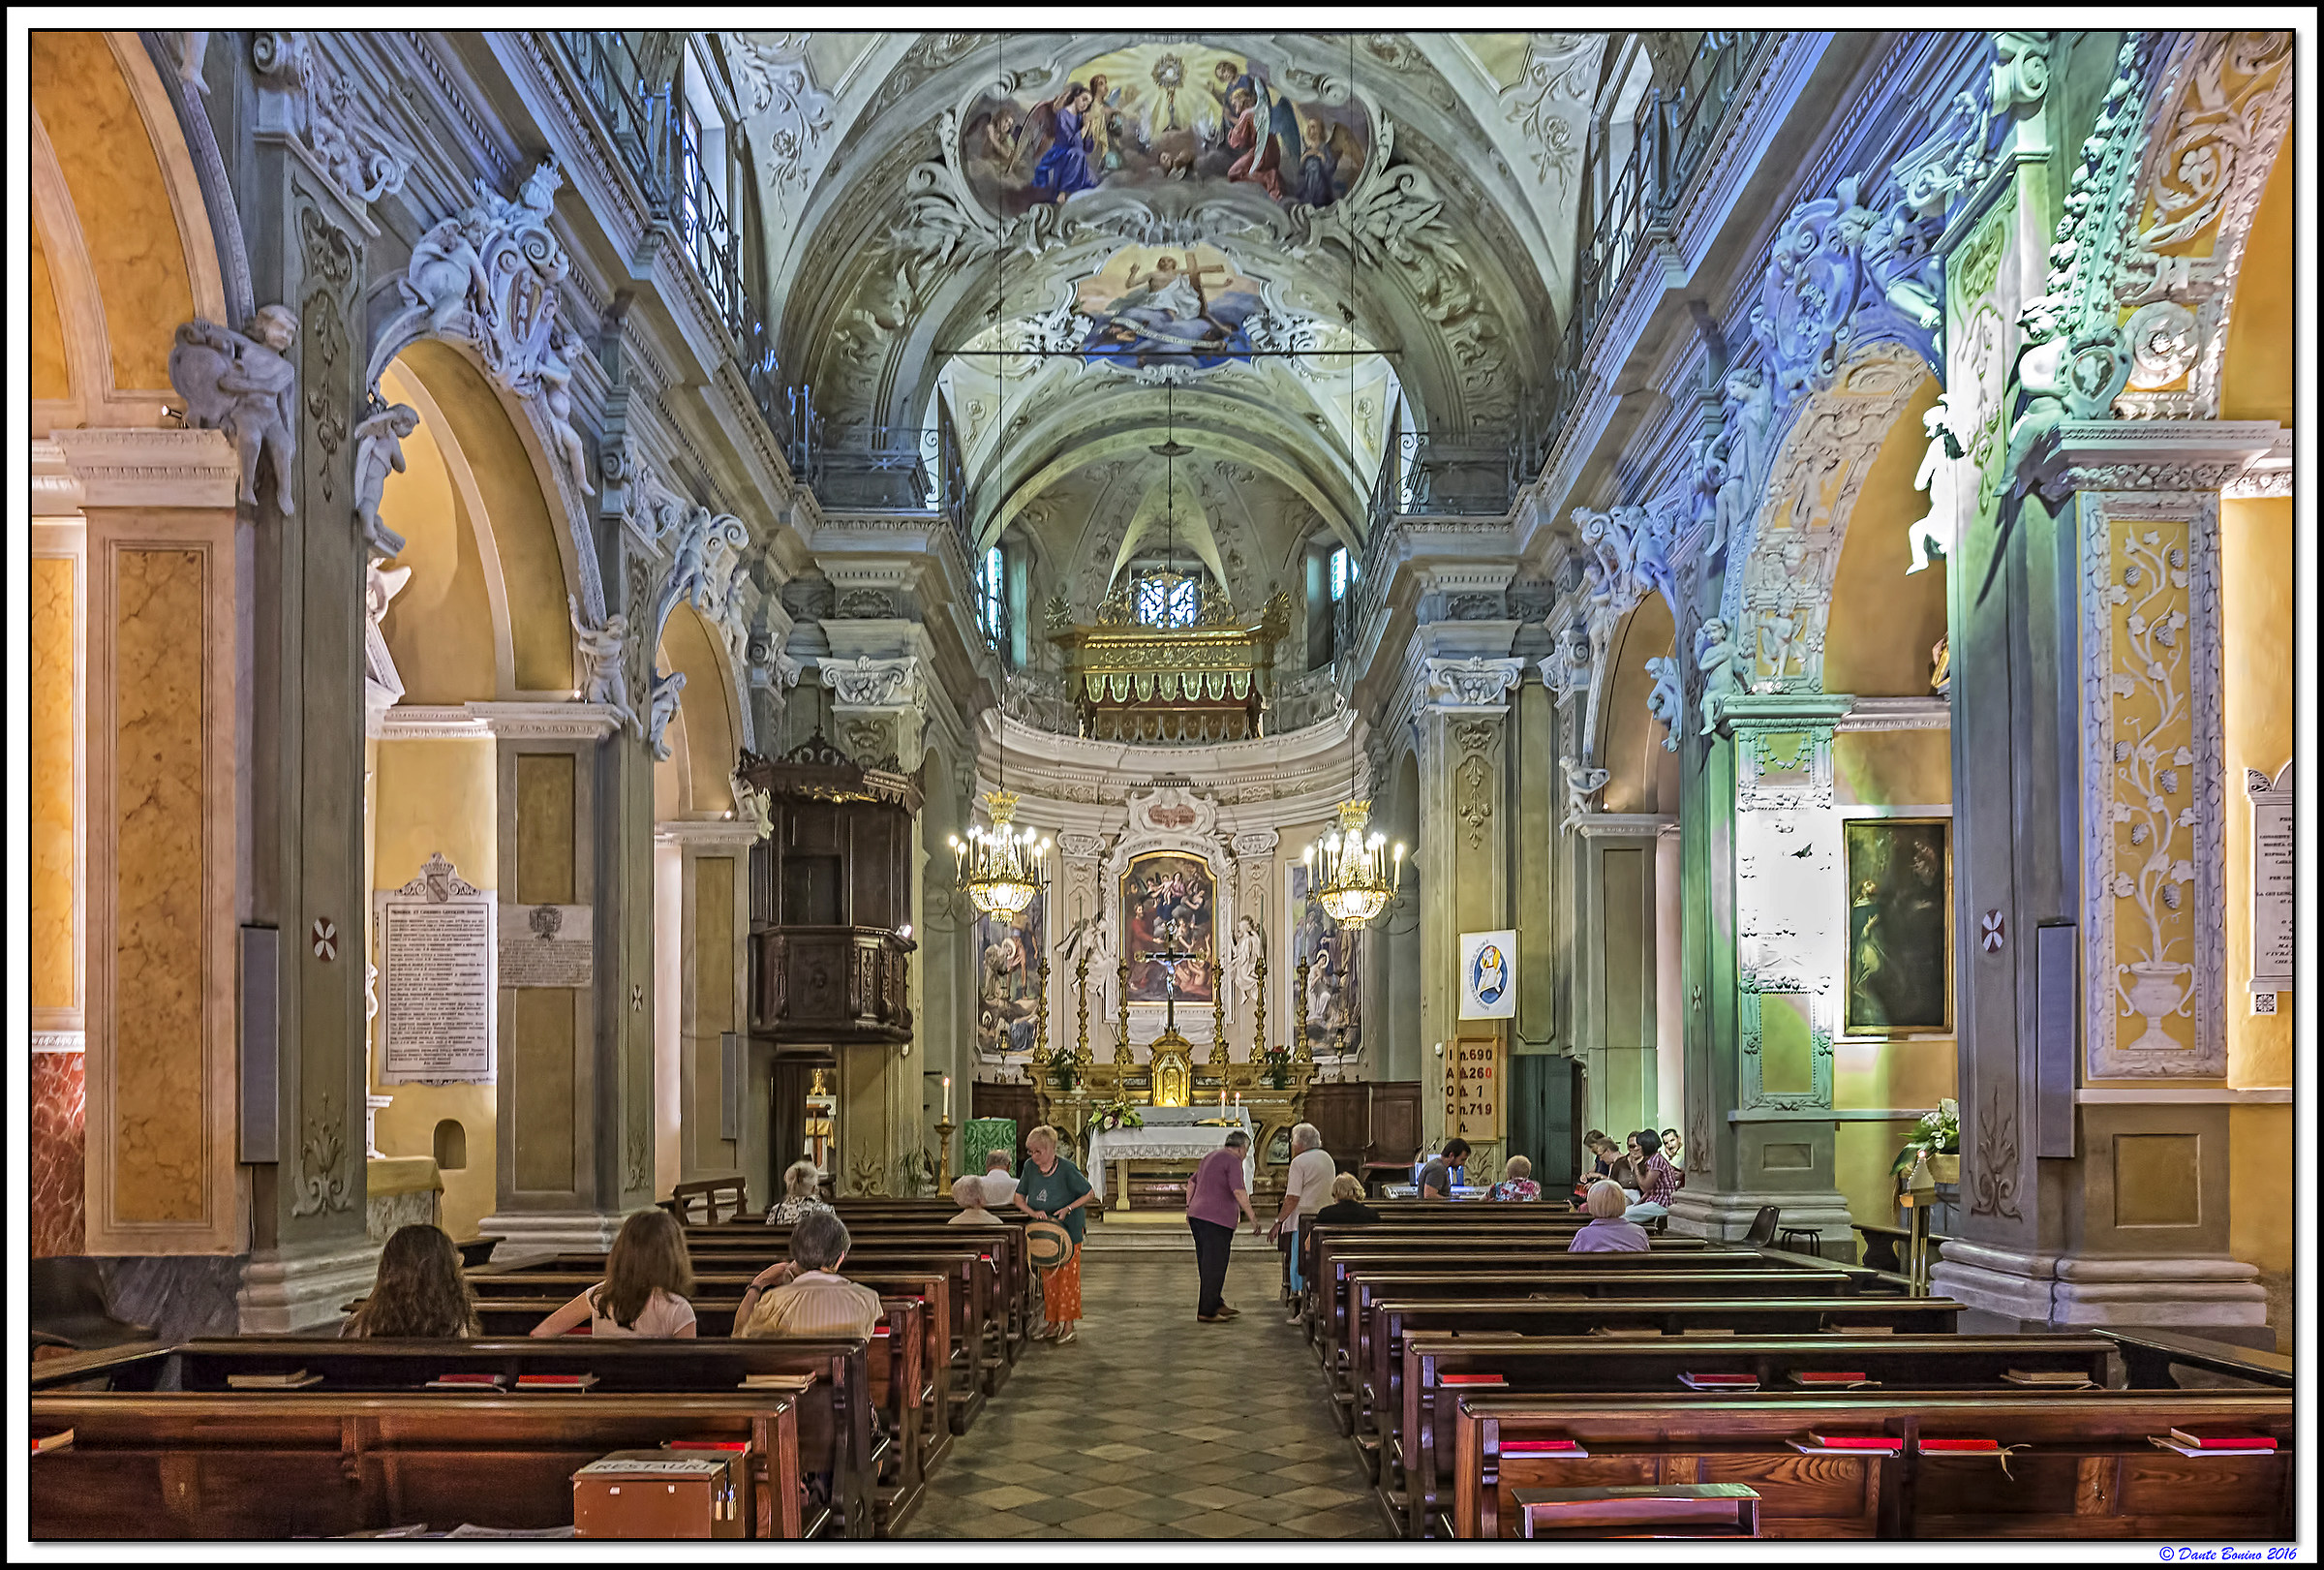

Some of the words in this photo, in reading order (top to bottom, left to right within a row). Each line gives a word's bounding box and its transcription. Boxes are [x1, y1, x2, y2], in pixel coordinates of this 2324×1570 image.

[1449, 1049, 1452, 1061] I
[1460, 1049, 1492, 1061] n.690
[1446, 1067, 1454, 1079] A
[1476, 1085, 1483, 1097] 1
[1447, 1103, 1454, 1115] C
[1459, 1103, 1492, 1115] n.719
[596, 1462, 710, 1471] RESTAURI
